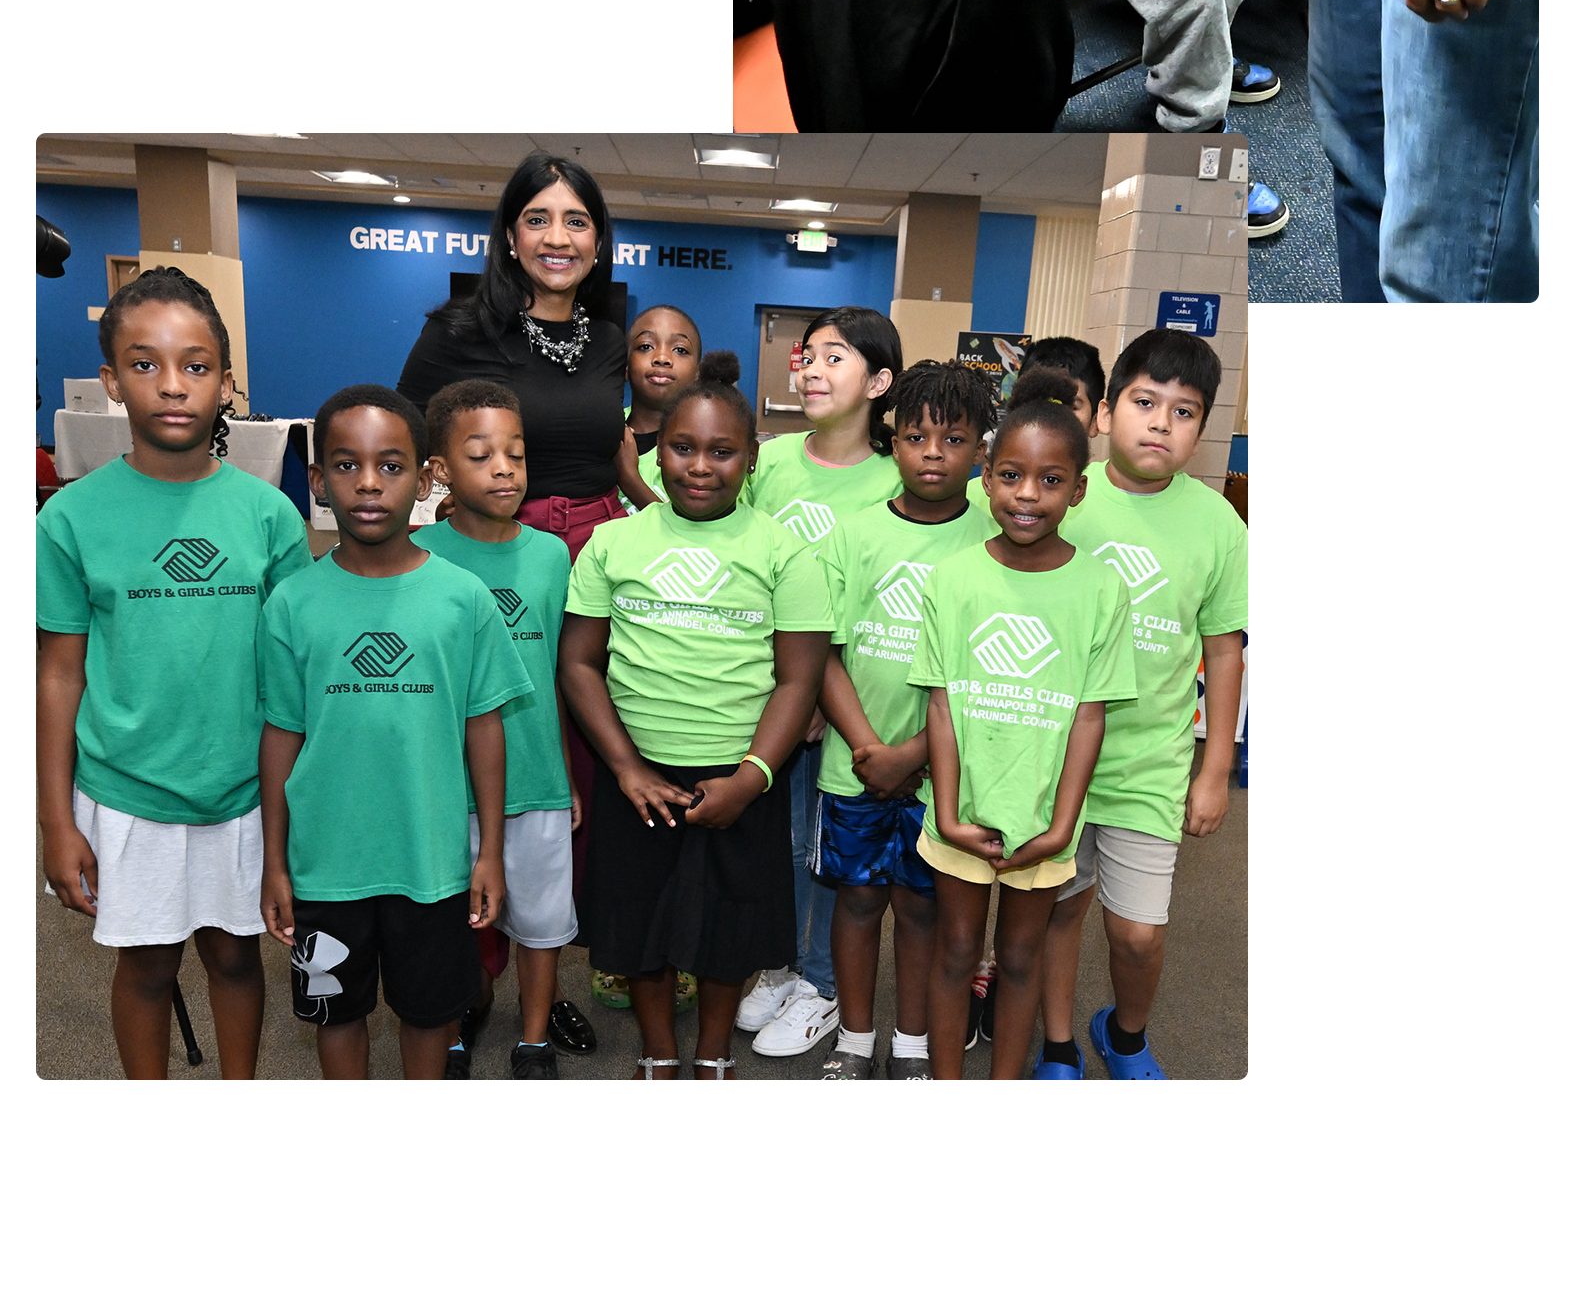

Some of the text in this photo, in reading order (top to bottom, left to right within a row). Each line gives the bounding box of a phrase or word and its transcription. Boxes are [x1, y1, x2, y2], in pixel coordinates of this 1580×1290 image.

[350, 226, 439, 254] GREAT
[446, 232, 491, 257] FUT
[658, 245, 733, 270] HERE.
[960, 353, 984, 362] BACK
[964, 361, 1003, 372] SCHOOL
[128, 586, 257, 599] BOYS & GIRLS CLUBS
[616, 596, 651, 611] BOYS
[647, 612, 660, 620] OF
[662, 610, 720, 622] ANNAPOLIS
[1132, 612, 1141, 625] S
[655, 618, 706, 631] ARUNDEL
[707, 622, 746, 637] COUNTY
[874, 622, 886, 636] &
[888, 625, 921, 641] GIRL
[1133, 627, 1144, 637] IS
[511, 632, 544, 640] S CLUBS
[868, 635, 878, 645] OF
[875, 648, 914, 664] ARUNDE
[352, 683, 362, 692] &
[364, 683, 399, 693] GIRLS
[402, 683, 434, 694] CLUBS
[969, 680, 983, 694] &
[986, 682, 1034, 700] GIRLS
[967, 696, 1045, 715] F ANNAPOLIS &
[970, 708, 1020, 724] ARUNDEL
